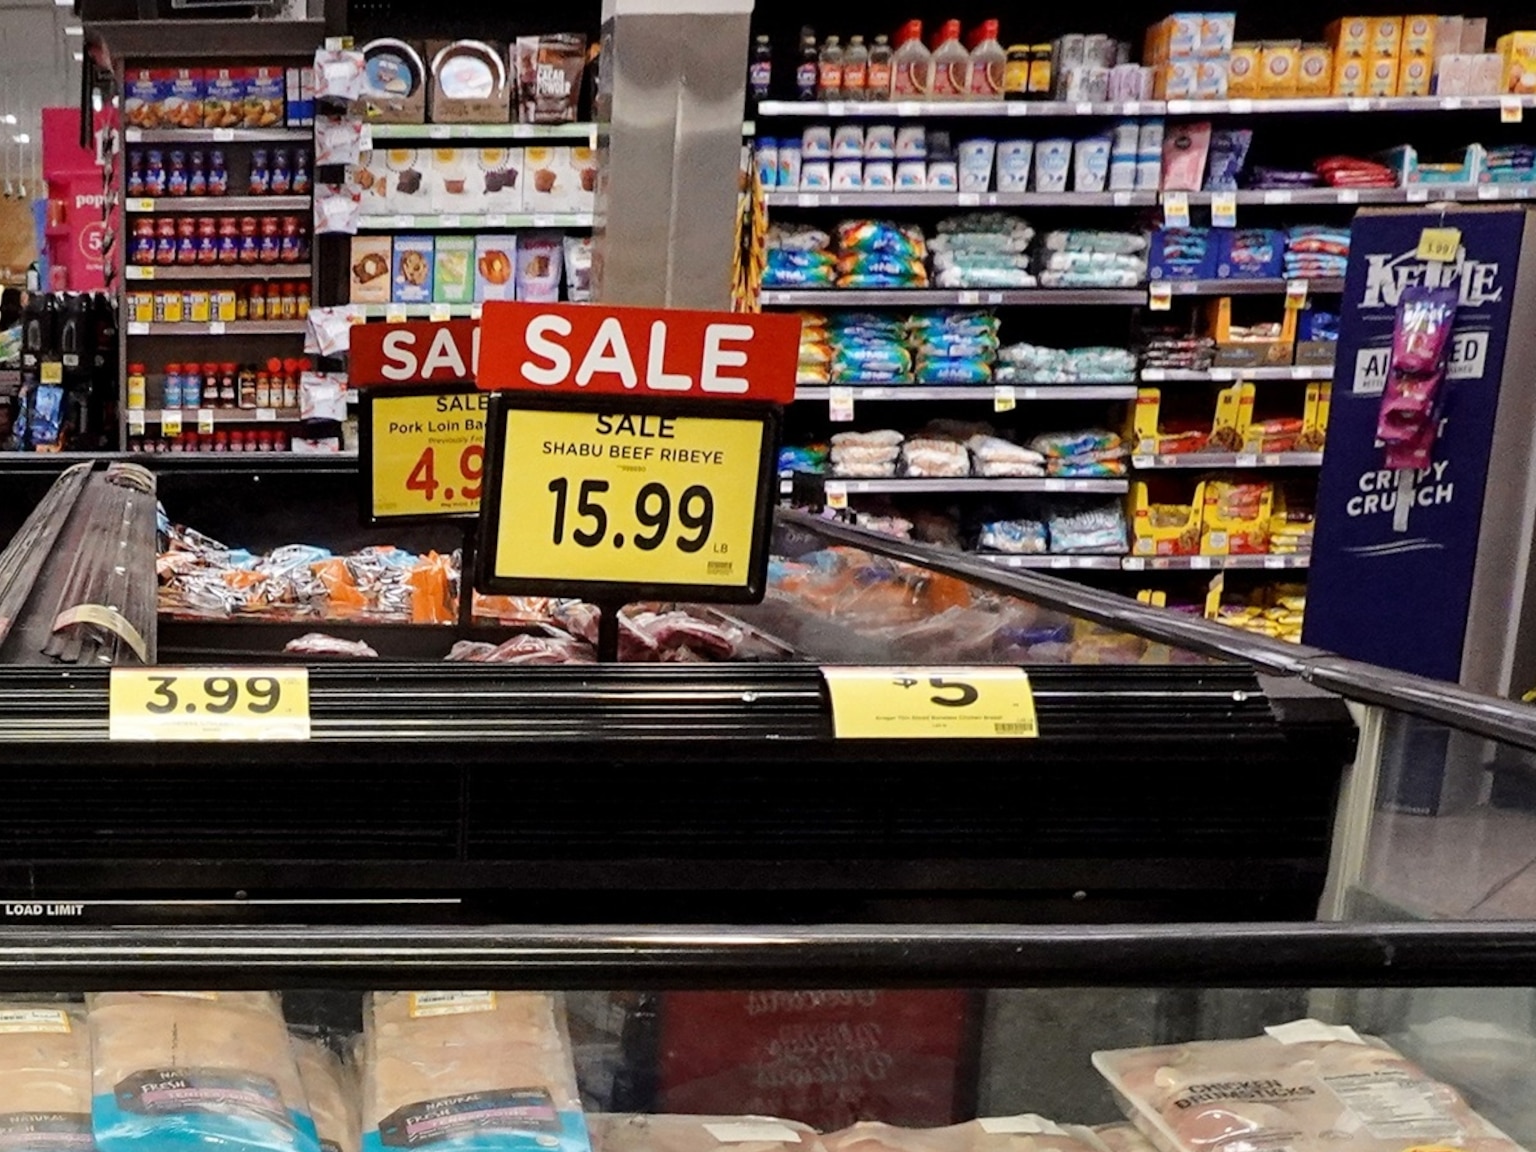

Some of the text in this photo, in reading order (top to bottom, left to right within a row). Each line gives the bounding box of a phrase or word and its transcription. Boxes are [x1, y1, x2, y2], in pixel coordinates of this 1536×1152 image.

[380, 327, 480, 380] SA
[520, 314, 755, 394] SALE
[389, 422, 423, 434] Pork
[428, 420, 460, 432] Loin
[596, 413, 675, 439] SALE
[542, 441, 724, 465] SHABU BEEF RIBEYE
[406, 444, 485, 501] 4.9
[1359, 460, 1449, 492] CRIPY
[548, 477, 714, 554] 15.99
[714, 543, 728, 553] LB
[146, 676, 281, 714] 3.99
[5, 904, 84, 916] LOAD LIMIT
[141, 1080, 185, 1093] FRESH
[1174, 1085, 1316, 1110] DRUMSTICKS
[1188, 1079, 1283, 1095] CHICKEN
[426, 1094, 482, 1110] NATURAL
[405, 1109, 451, 1125] FRESH
